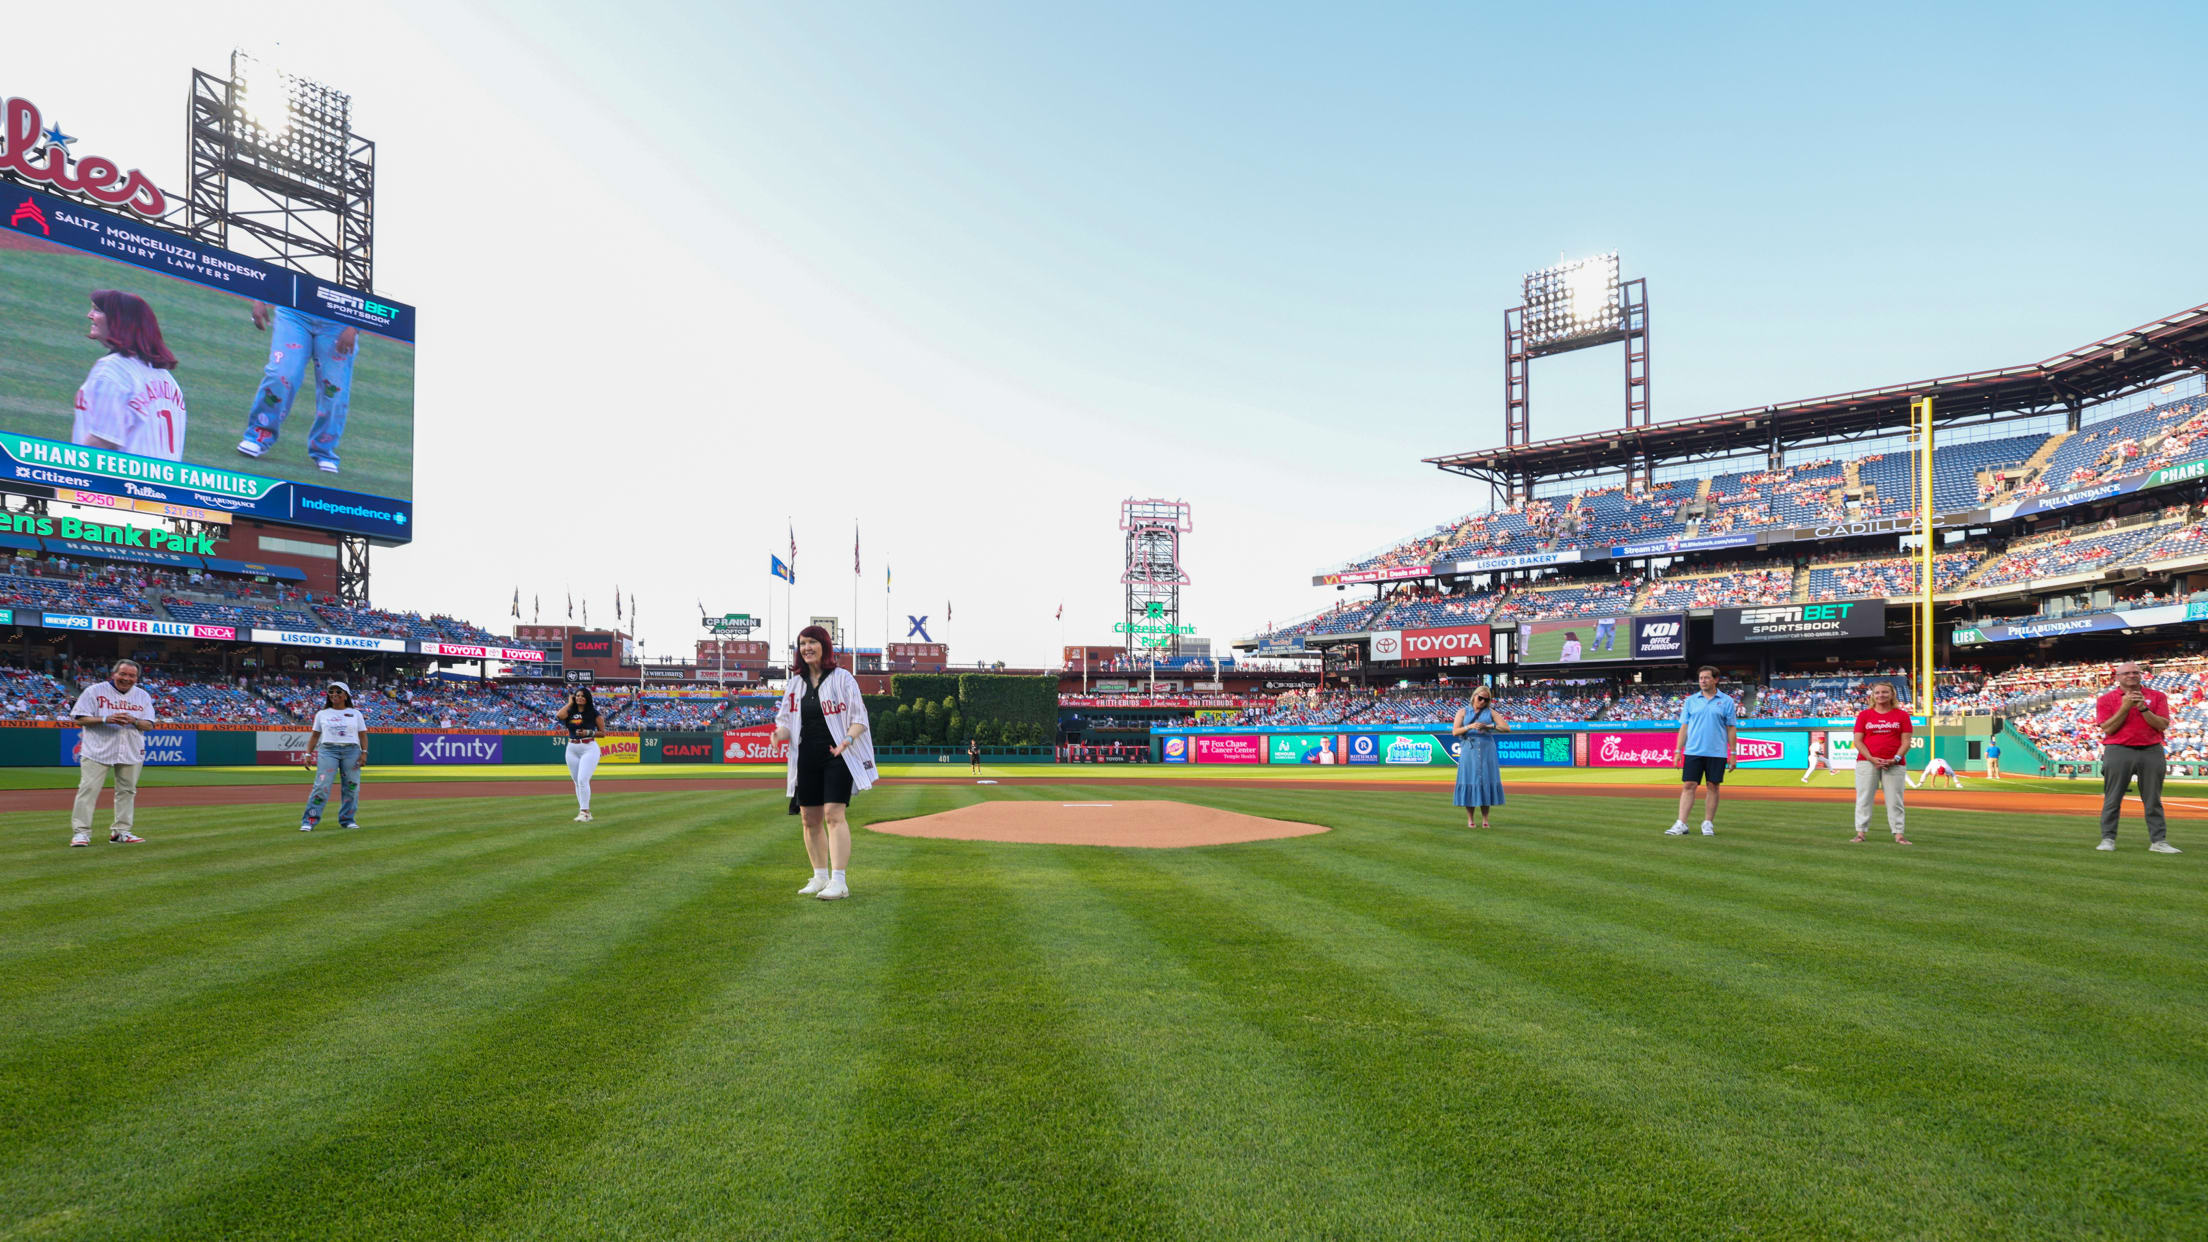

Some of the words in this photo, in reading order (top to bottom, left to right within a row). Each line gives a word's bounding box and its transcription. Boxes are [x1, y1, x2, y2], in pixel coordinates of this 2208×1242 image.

[0, 97, 167, 219] lies
[55, 210, 100, 232] SALTZ
[106, 225, 197, 261] MONGELUZZI
[202, 254, 267, 282] BENDESKY
[100, 237, 156, 260] INJURY
[167, 256, 230, 281] LAWYERS
[326, 302, 391, 326] SPORTSBOOK
[364, 300, 400, 320] BET
[19, 440, 90, 468] PHANS
[96, 453, 175, 482] FEEDING
[180, 468, 258, 495] FAMILIES
[32, 469, 91, 487] Citizens
[124, 482, 167, 499] Phillies
[2039, 484, 2121, 509] PHILABUNDANCE
[2160, 463, 2205, 483] PHANS
[301, 497, 391, 521] Independence
[1815, 515, 1945, 537] CADILLAC
[61, 516, 145, 547] Bank
[150, 528, 216, 556] Park
[1624, 546, 1651, 554] Stream
[1477, 557, 1517, 570] LISCIO'S
[1519, 554, 1558, 566] BAKERY
[1740, 606, 1802, 624] ESPN
[1803, 603, 1854, 621] BET
[97, 618, 148, 633] POWER
[152, 622, 192, 636] ALLEY
[197, 626, 234, 638] NECA
[1114, 622, 1163, 634] Citizens
[1165, 623, 1196, 635] Bank
[1642, 622, 1680, 637] KDI
[1752, 621, 1840, 634] SPORTSBOOK
[2008, 619, 2092, 639] PHILABUNDANCE
[281, 633, 332, 645] LISCIO'S
[336, 637, 381, 649] BAKERY
[575, 642, 609, 651] GIANT
[1141, 635, 1168, 648] Park
[1406, 632, 1482, 651] TOYOTA
[1641, 643, 1680, 651] TECHNOLOGY
[441, 645, 483, 656] TOYOTA
[505, 650, 542, 660] TOYOTA
[96, 695, 144, 712] Phillies
[213, 724, 270, 732] ASPLUNDH
[418, 736, 498, 761] xfinity
[553, 737, 566, 746] 374
[600, 742, 639, 757] MASON
[644, 738, 658, 747] 387
[1498, 741, 1519, 749] SCAN
[1520, 741, 1541, 749] HERE
[663, 744, 712, 756] GIANT
[746, 743, 779, 758] State
[938, 754, 950, 762] 401
[1498, 750, 1509, 759] TO
[1510, 750, 1541, 759] DONATE
[1600, 740, 1673, 764] Chick-fil-A
